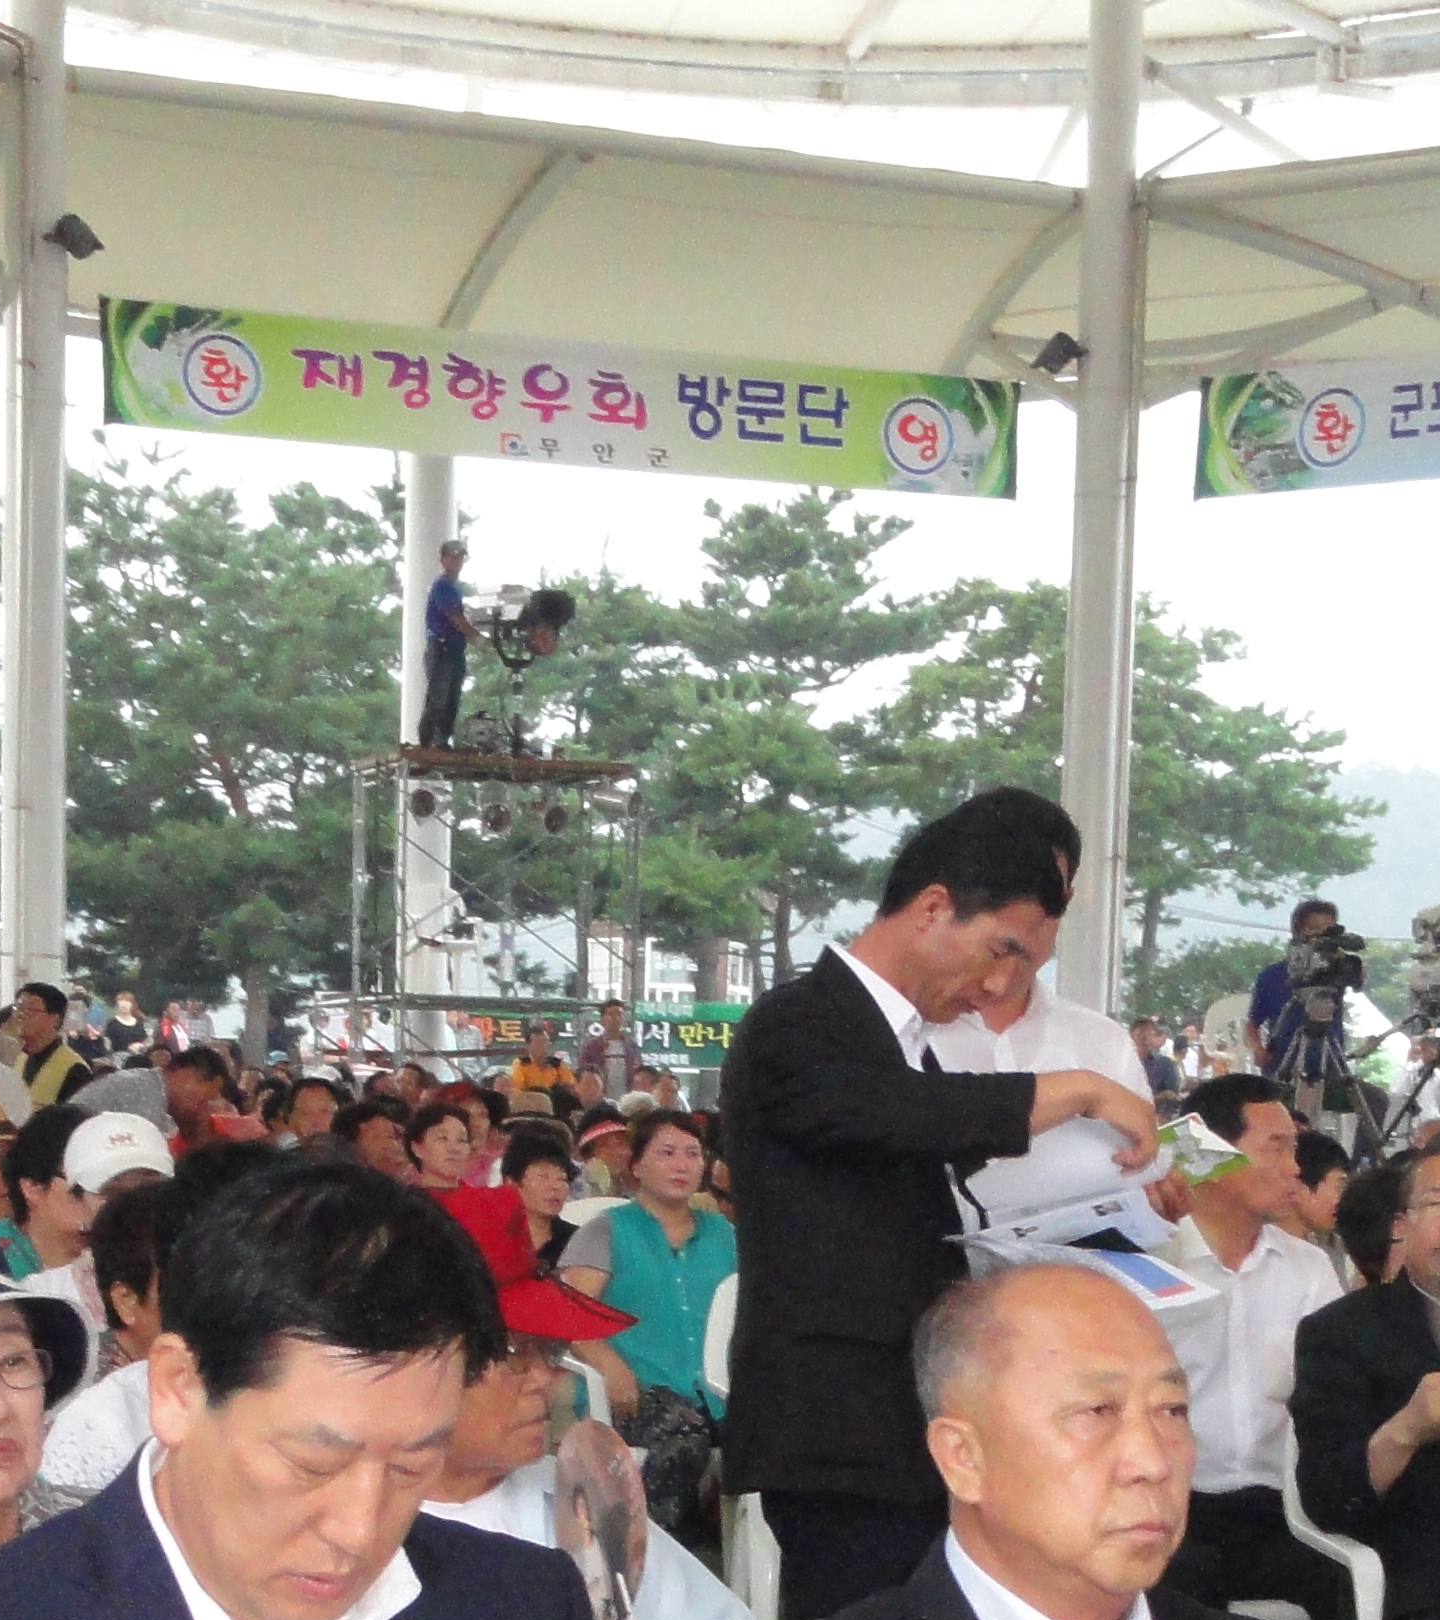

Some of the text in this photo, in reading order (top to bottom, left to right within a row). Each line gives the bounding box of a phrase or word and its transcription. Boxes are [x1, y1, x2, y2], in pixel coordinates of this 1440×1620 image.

[199, 347, 941, 463] 환 재경향우회 방문단 영
[1312, 402, 1356, 455] 환
